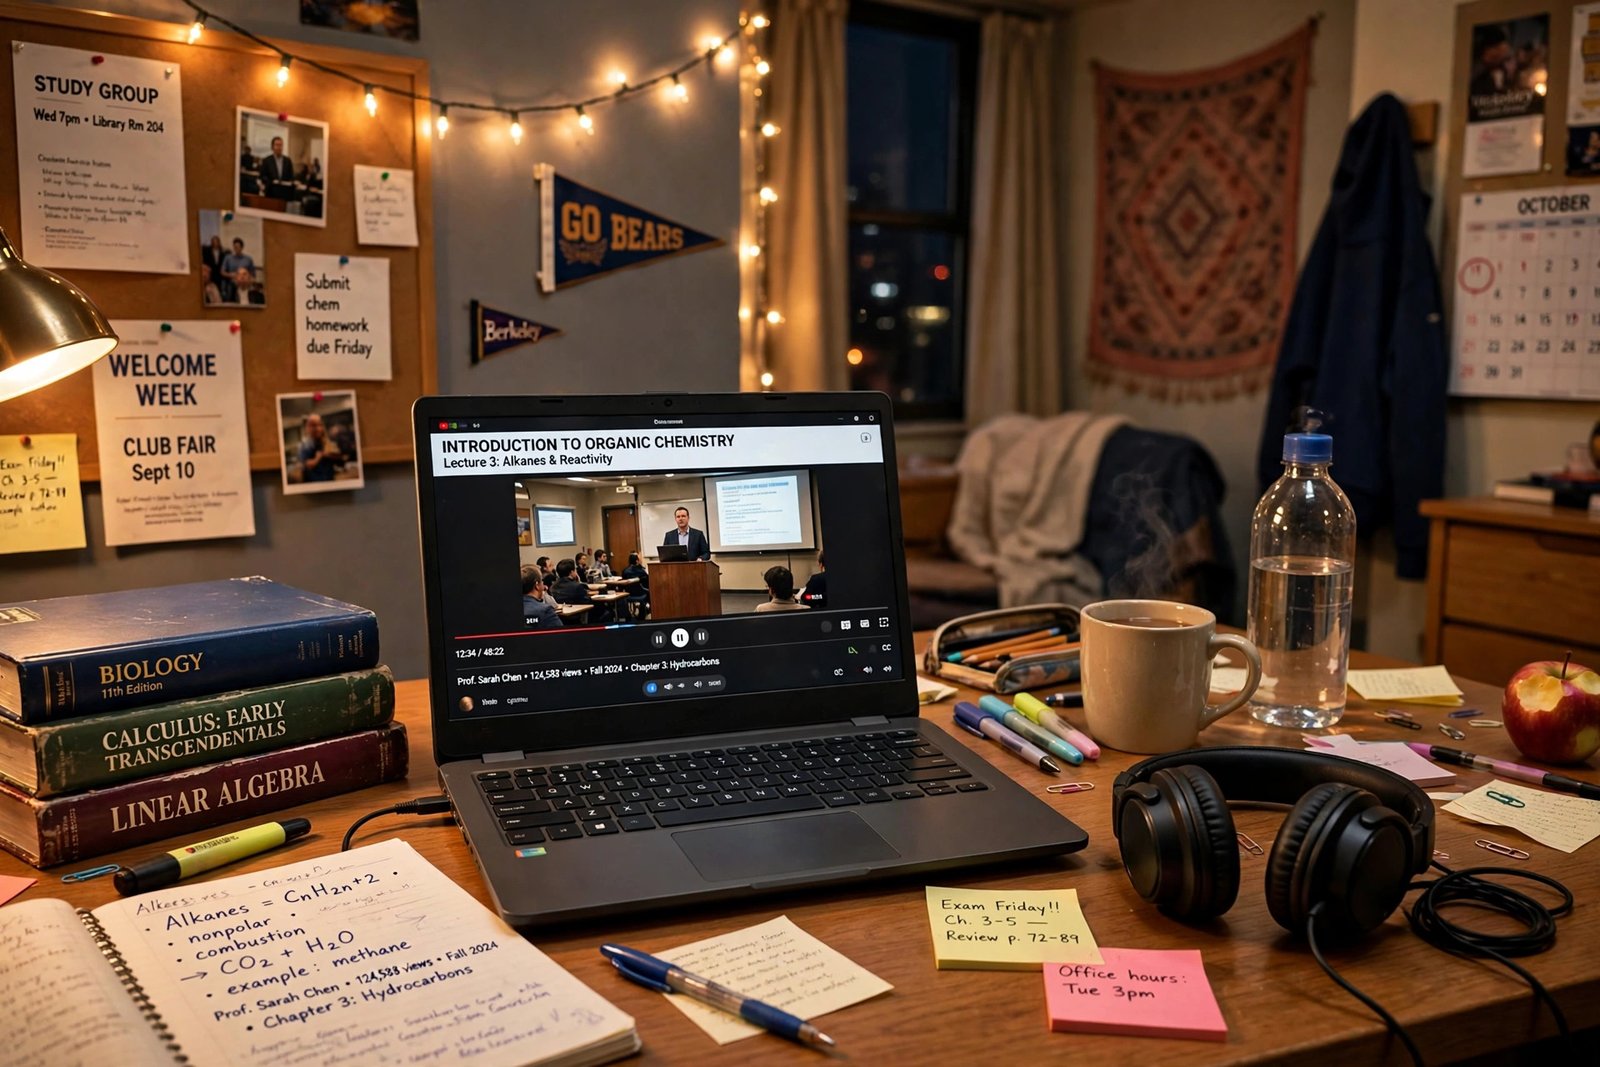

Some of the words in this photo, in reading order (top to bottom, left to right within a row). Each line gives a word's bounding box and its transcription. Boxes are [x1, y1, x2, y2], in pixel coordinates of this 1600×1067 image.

[34, 75, 93, 96] STUDY
[99, 82, 158, 104] GROUP
[34, 107, 56, 122] Wed
[59, 111, 80, 126] 7pm
[93, 114, 125, 132] Library
[129, 119, 144, 131] Rm
[147, 121, 164, 133] 204
[1517, 194, 1591, 215] OCTOBER
[561, 202, 601, 242] GO
[611, 213, 684, 251] BEARS
[306, 273, 350, 290] Submit
[306, 295, 340, 310] chem
[306, 317, 368, 332] homework
[306, 338, 330, 354] due
[334, 339, 372, 359] Friday
[109, 354, 216, 377] WELCOME
[136, 383, 198, 406] WEEK
[124, 437, 172, 456] CLUB
[177, 435, 216, 454] FAIR
[442, 438, 557, 453] INTRODUCTION
[560, 437, 582, 450] TO
[585, 436, 651, 450] ORGANIC
[654, 434, 735, 448] CHEMISTRY
[444, 458, 486, 468] Lecture
[490, 456, 500, 466] 3:
[502, 455, 546, 466] Alkanes
[549, 454, 557, 465] &
[560, 453, 613, 466] Reactivity
[132, 463, 171, 484] Sept
[176, 462, 194, 479] 10
[456, 648, 476, 658] 12:34
[484, 647, 504, 656] 48:22
[98, 652, 204, 685] BIOLOGY
[458, 676, 476, 686] Prof.
[478, 674, 500, 684] Sarah
[502, 673, 522, 682] Chen
[530, 670, 560, 680] 124,583
[561, 668, 582, 676] views
[590, 665, 603, 675] Fall
[604, 664, 622, 674] 2024
[630, 662, 660, 673] Chapter
[662, 661, 669, 669] 3:
[670, 657, 720, 671] Hydrocarbons
[102, 684, 124, 700] 11th
[126, 680, 164, 695] Edition
[102, 712, 222, 750] CALCULUS:
[226, 700, 286, 728] EARLY
[105, 720, 286, 772] TRANSCENDENTALS
[110, 788, 210, 832] LINEAR
[218, 760, 326, 808] ALGEBRA
[166, 904, 250, 930] Alkanes
[942, 899, 985, 911] Exam
[996, 900, 1060, 916] Friday!!
[188, 918, 272, 944] nonpolar
[944, 914, 972, 926] Ch.
[982, 916, 1017, 926] 3-5
[196, 927, 306, 960] combustion
[946, 930, 998, 942] Review
[1008, 934, 1020, 946] p.
[1027, 933, 1080, 944] 72-89
[332, 940, 412, 968] methane
[214, 1004, 252, 1022] Prof.
[256, 992, 300, 1010] Sarah
[304, 984, 340, 998] Chen
[402, 959, 434, 973] views
[446, 948, 466, 962] Fall
[470, 940, 498, 956] 2024
[1058, 965, 1116, 979] Office
[1128, 969, 1187, 984] hours:
[264, 1002, 334, 1028] Chapter
[337, 996, 356, 1008] 3:
[361, 966, 473, 1002] Hydrocarbons
[1062, 982, 1100, 996] Tue
[1113, 986, 1155, 1002] 3pm
